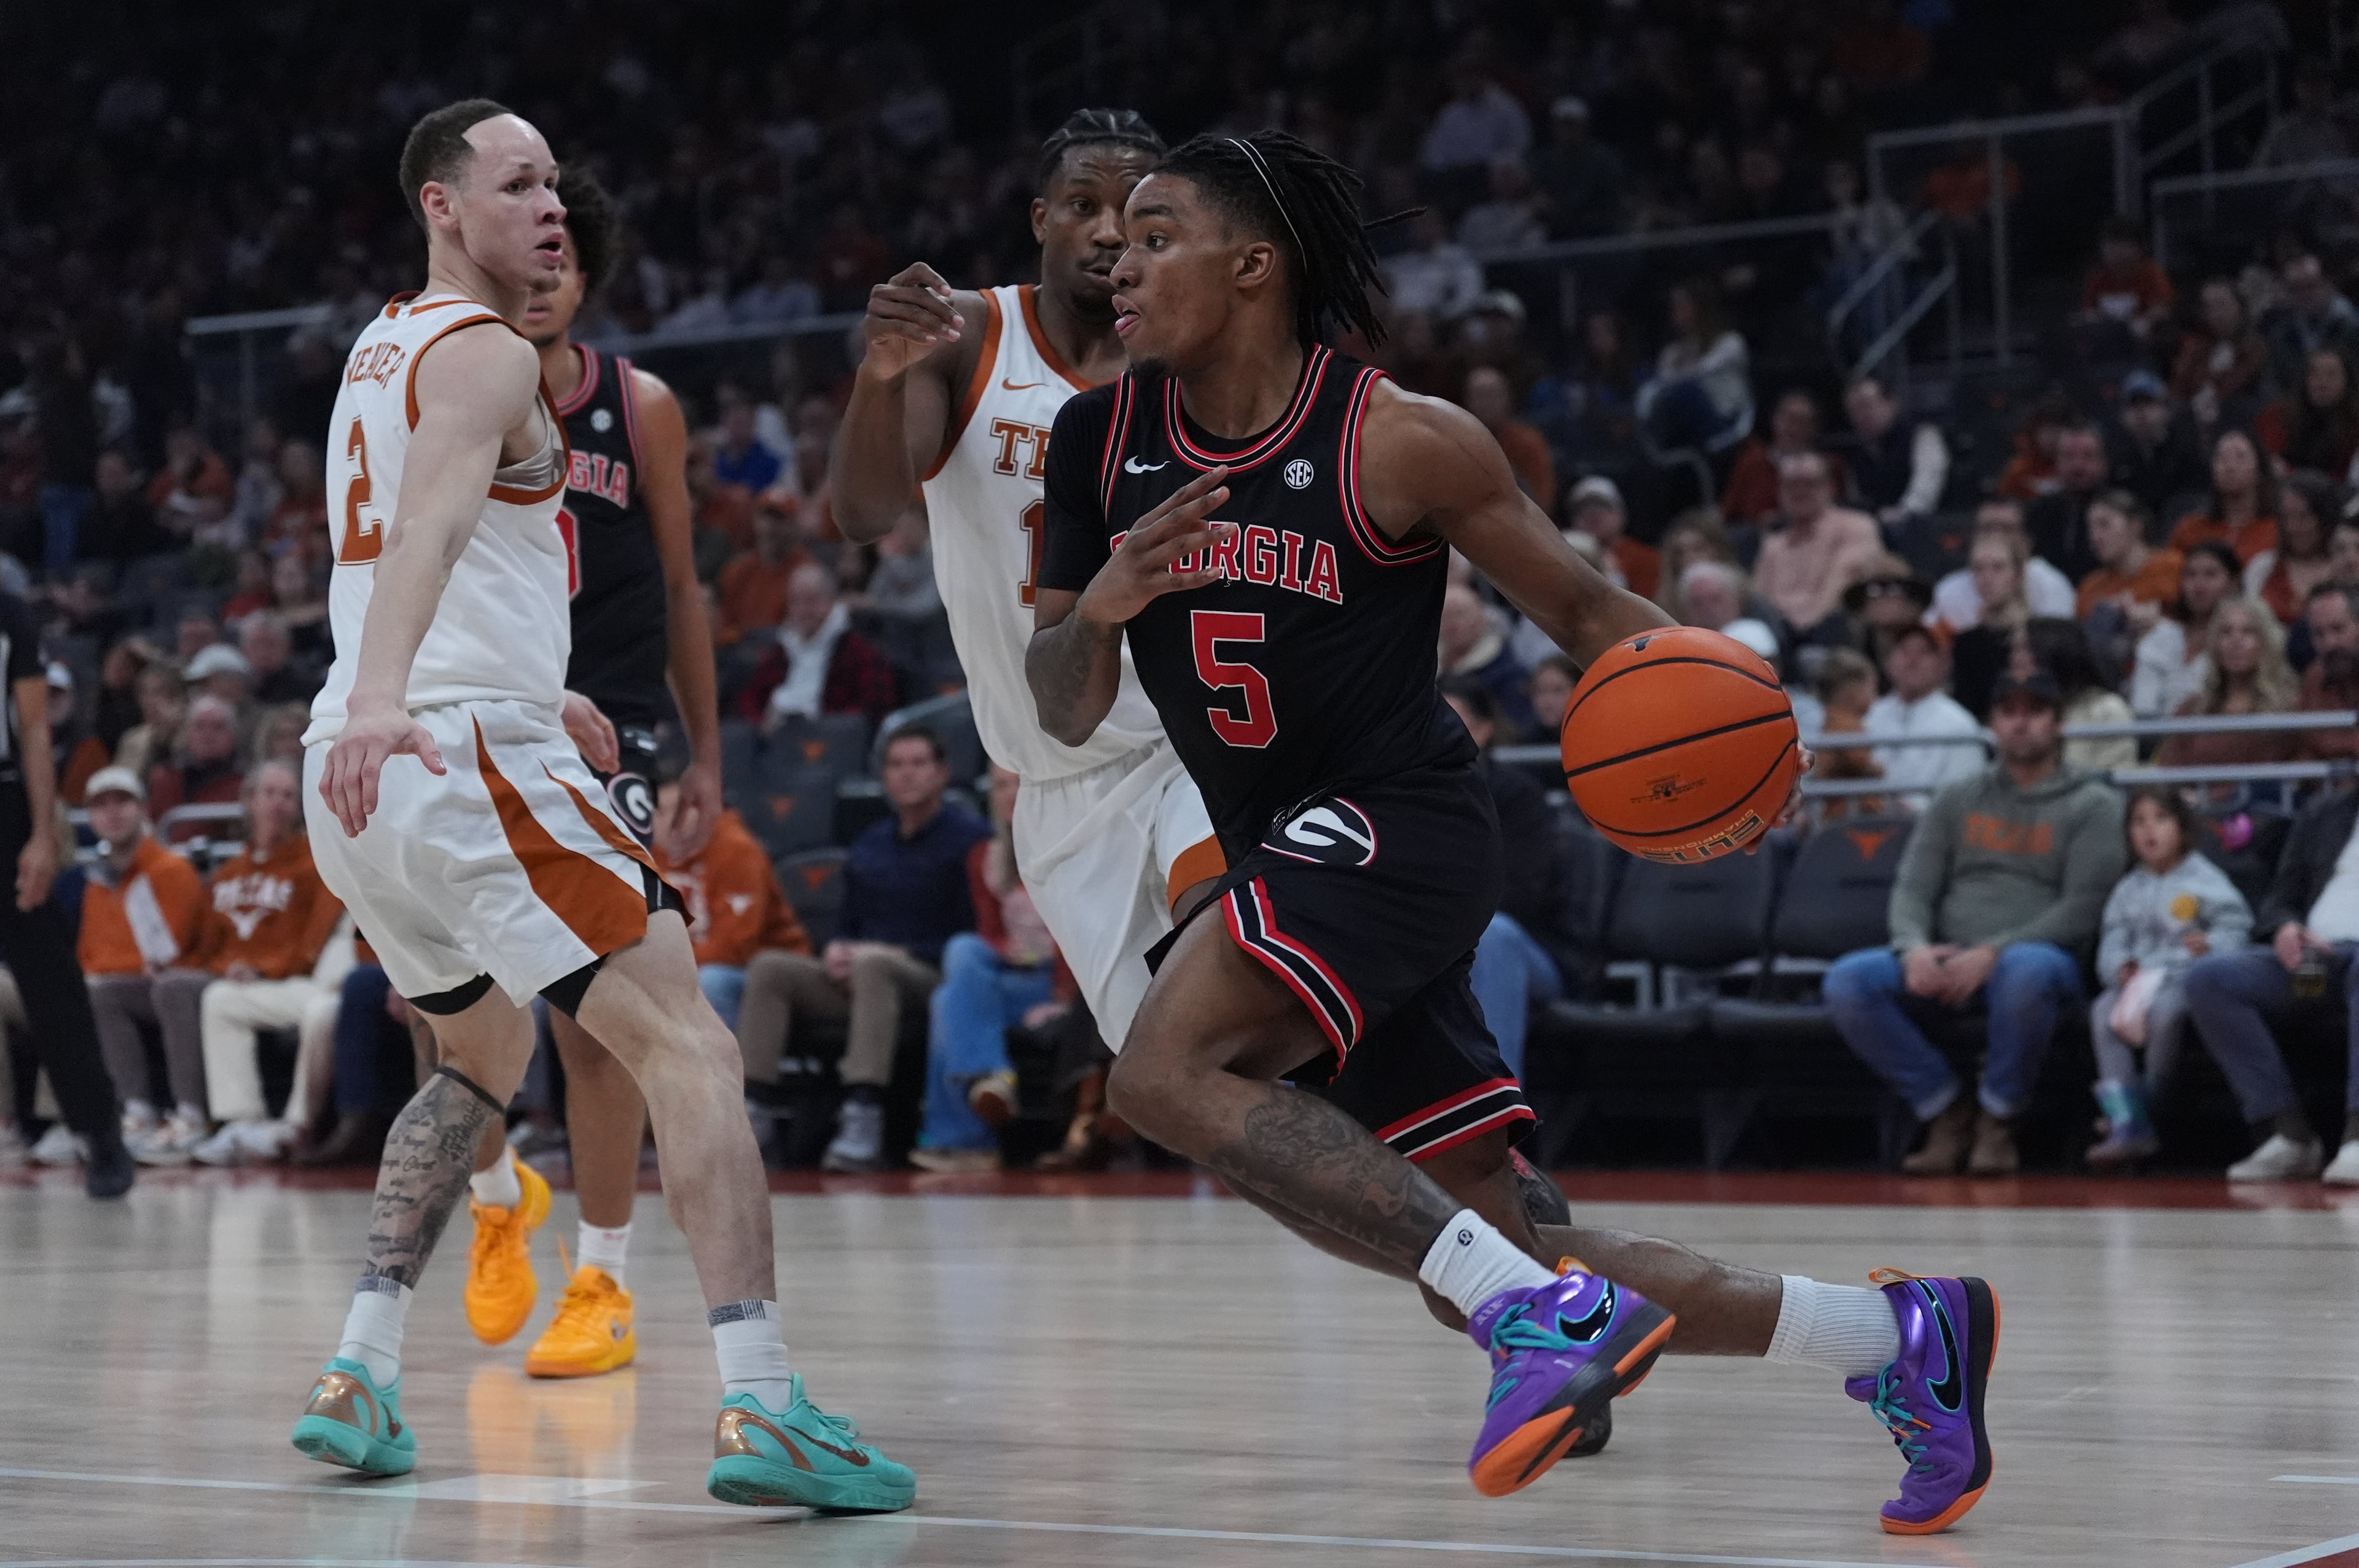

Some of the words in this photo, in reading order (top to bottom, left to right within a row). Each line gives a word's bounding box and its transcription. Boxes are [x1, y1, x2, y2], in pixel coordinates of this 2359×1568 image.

[337, 414, 385, 566] 2
[1286, 461, 1312, 488] SEC
[1110, 521, 1344, 606] ORGIA
[1190, 610, 1278, 749] 5
[1641, 813, 1764, 862] ELITE
